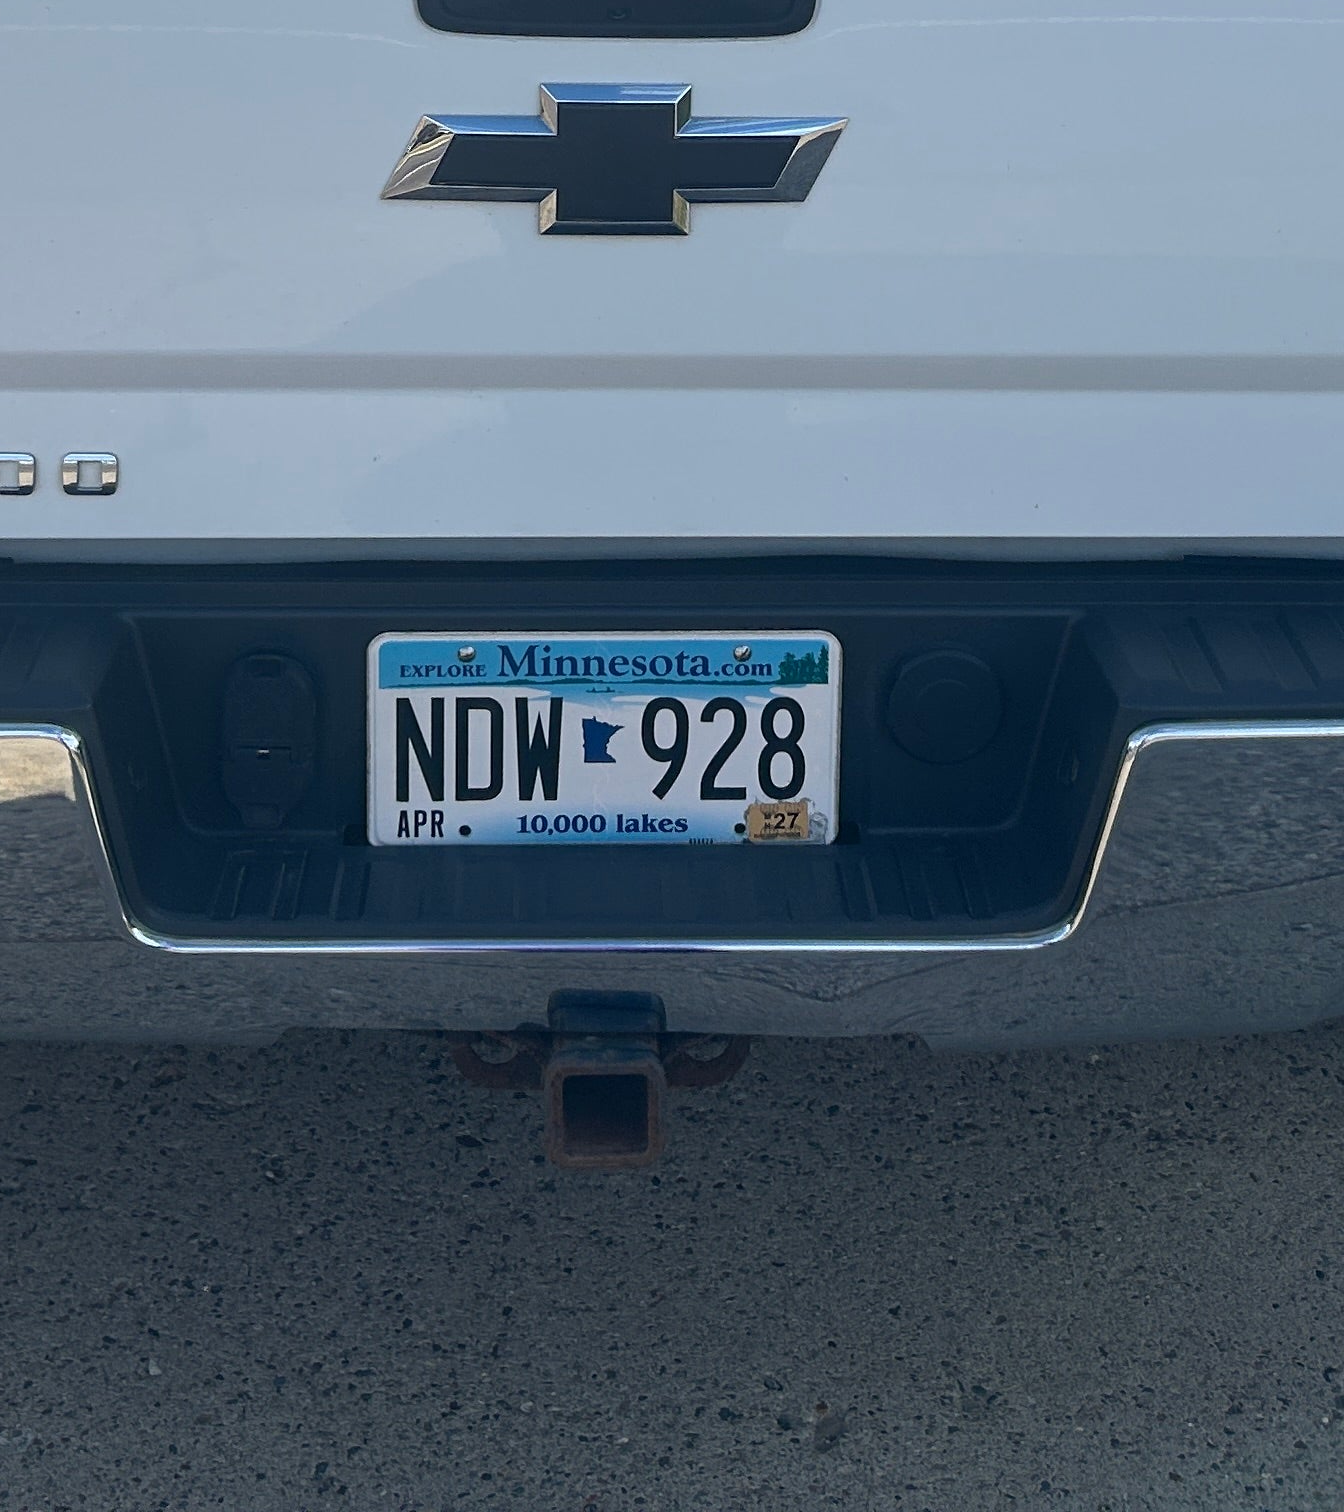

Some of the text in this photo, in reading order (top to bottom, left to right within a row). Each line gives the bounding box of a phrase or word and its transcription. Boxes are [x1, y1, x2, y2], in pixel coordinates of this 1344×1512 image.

[399, 644, 773, 678] EXPLORE Minnesota.com
[395, 696, 806, 803] NDW 928
[397, 809, 445, 838] APR
[516, 813, 689, 838] 10,000 lakes
[774, 812, 800, 830] 27
